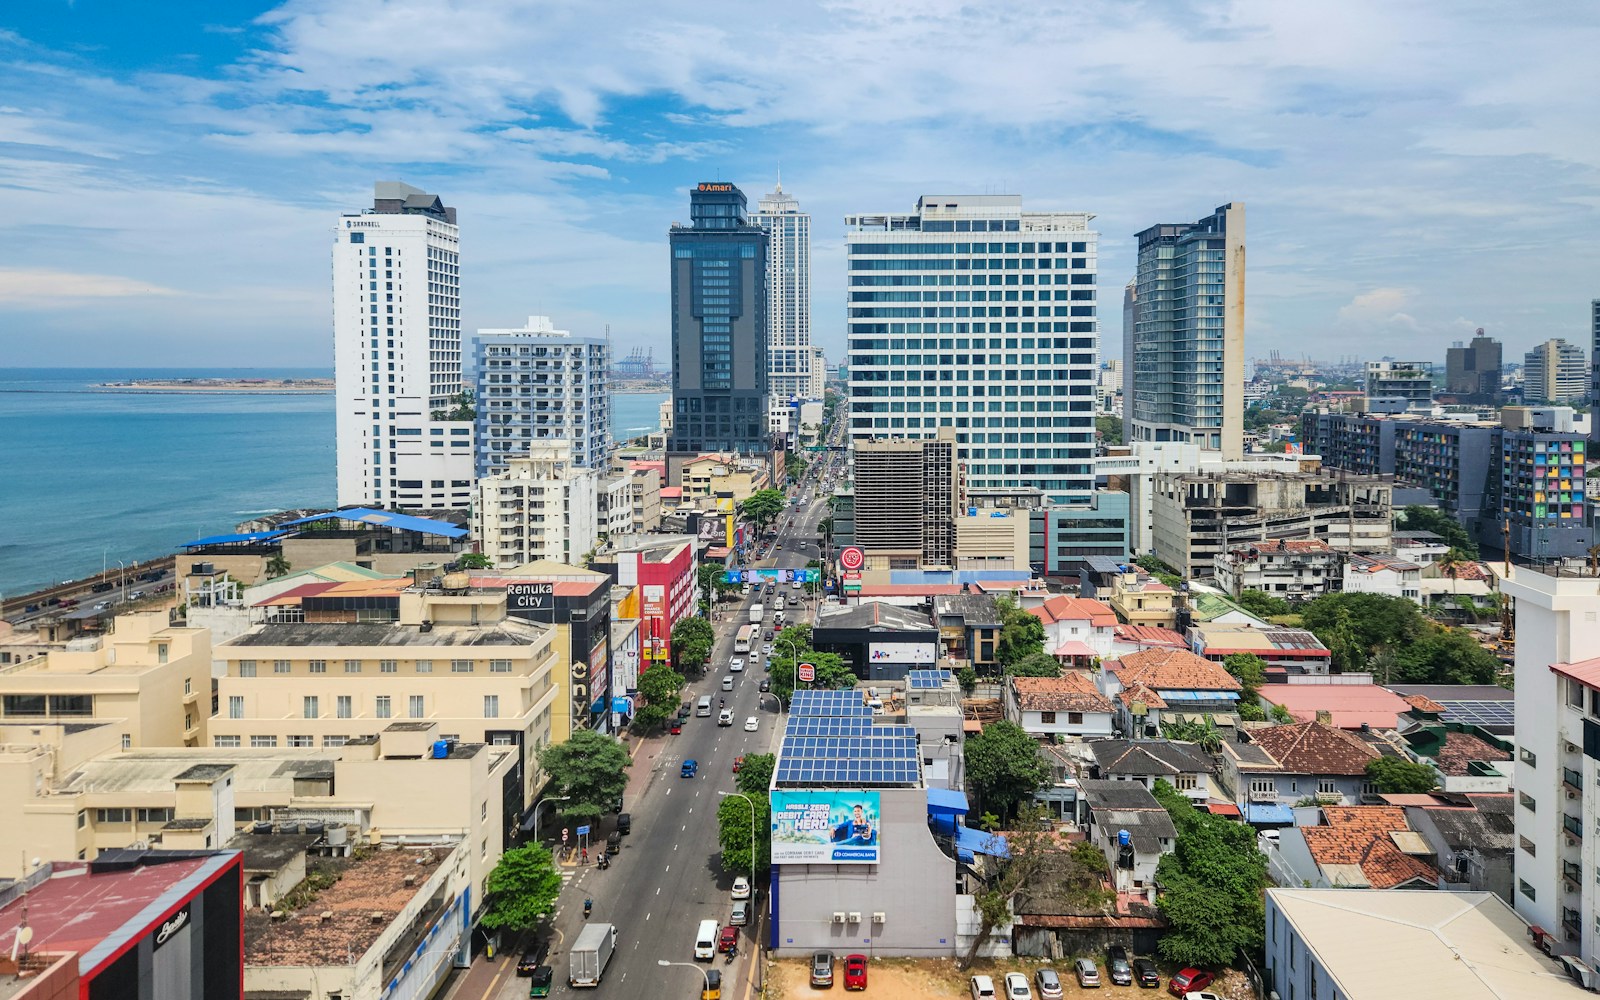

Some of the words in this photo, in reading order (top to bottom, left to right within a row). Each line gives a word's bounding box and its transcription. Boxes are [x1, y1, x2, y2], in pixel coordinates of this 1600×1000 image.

[705, 183, 732, 192] Amari
[507, 584, 552, 595] Renuka
[517, 595, 542, 607] City
[777, 811, 803, 819] DEBIT
[803, 811, 829, 819] CARD
[794, 819, 828, 830] HERO
